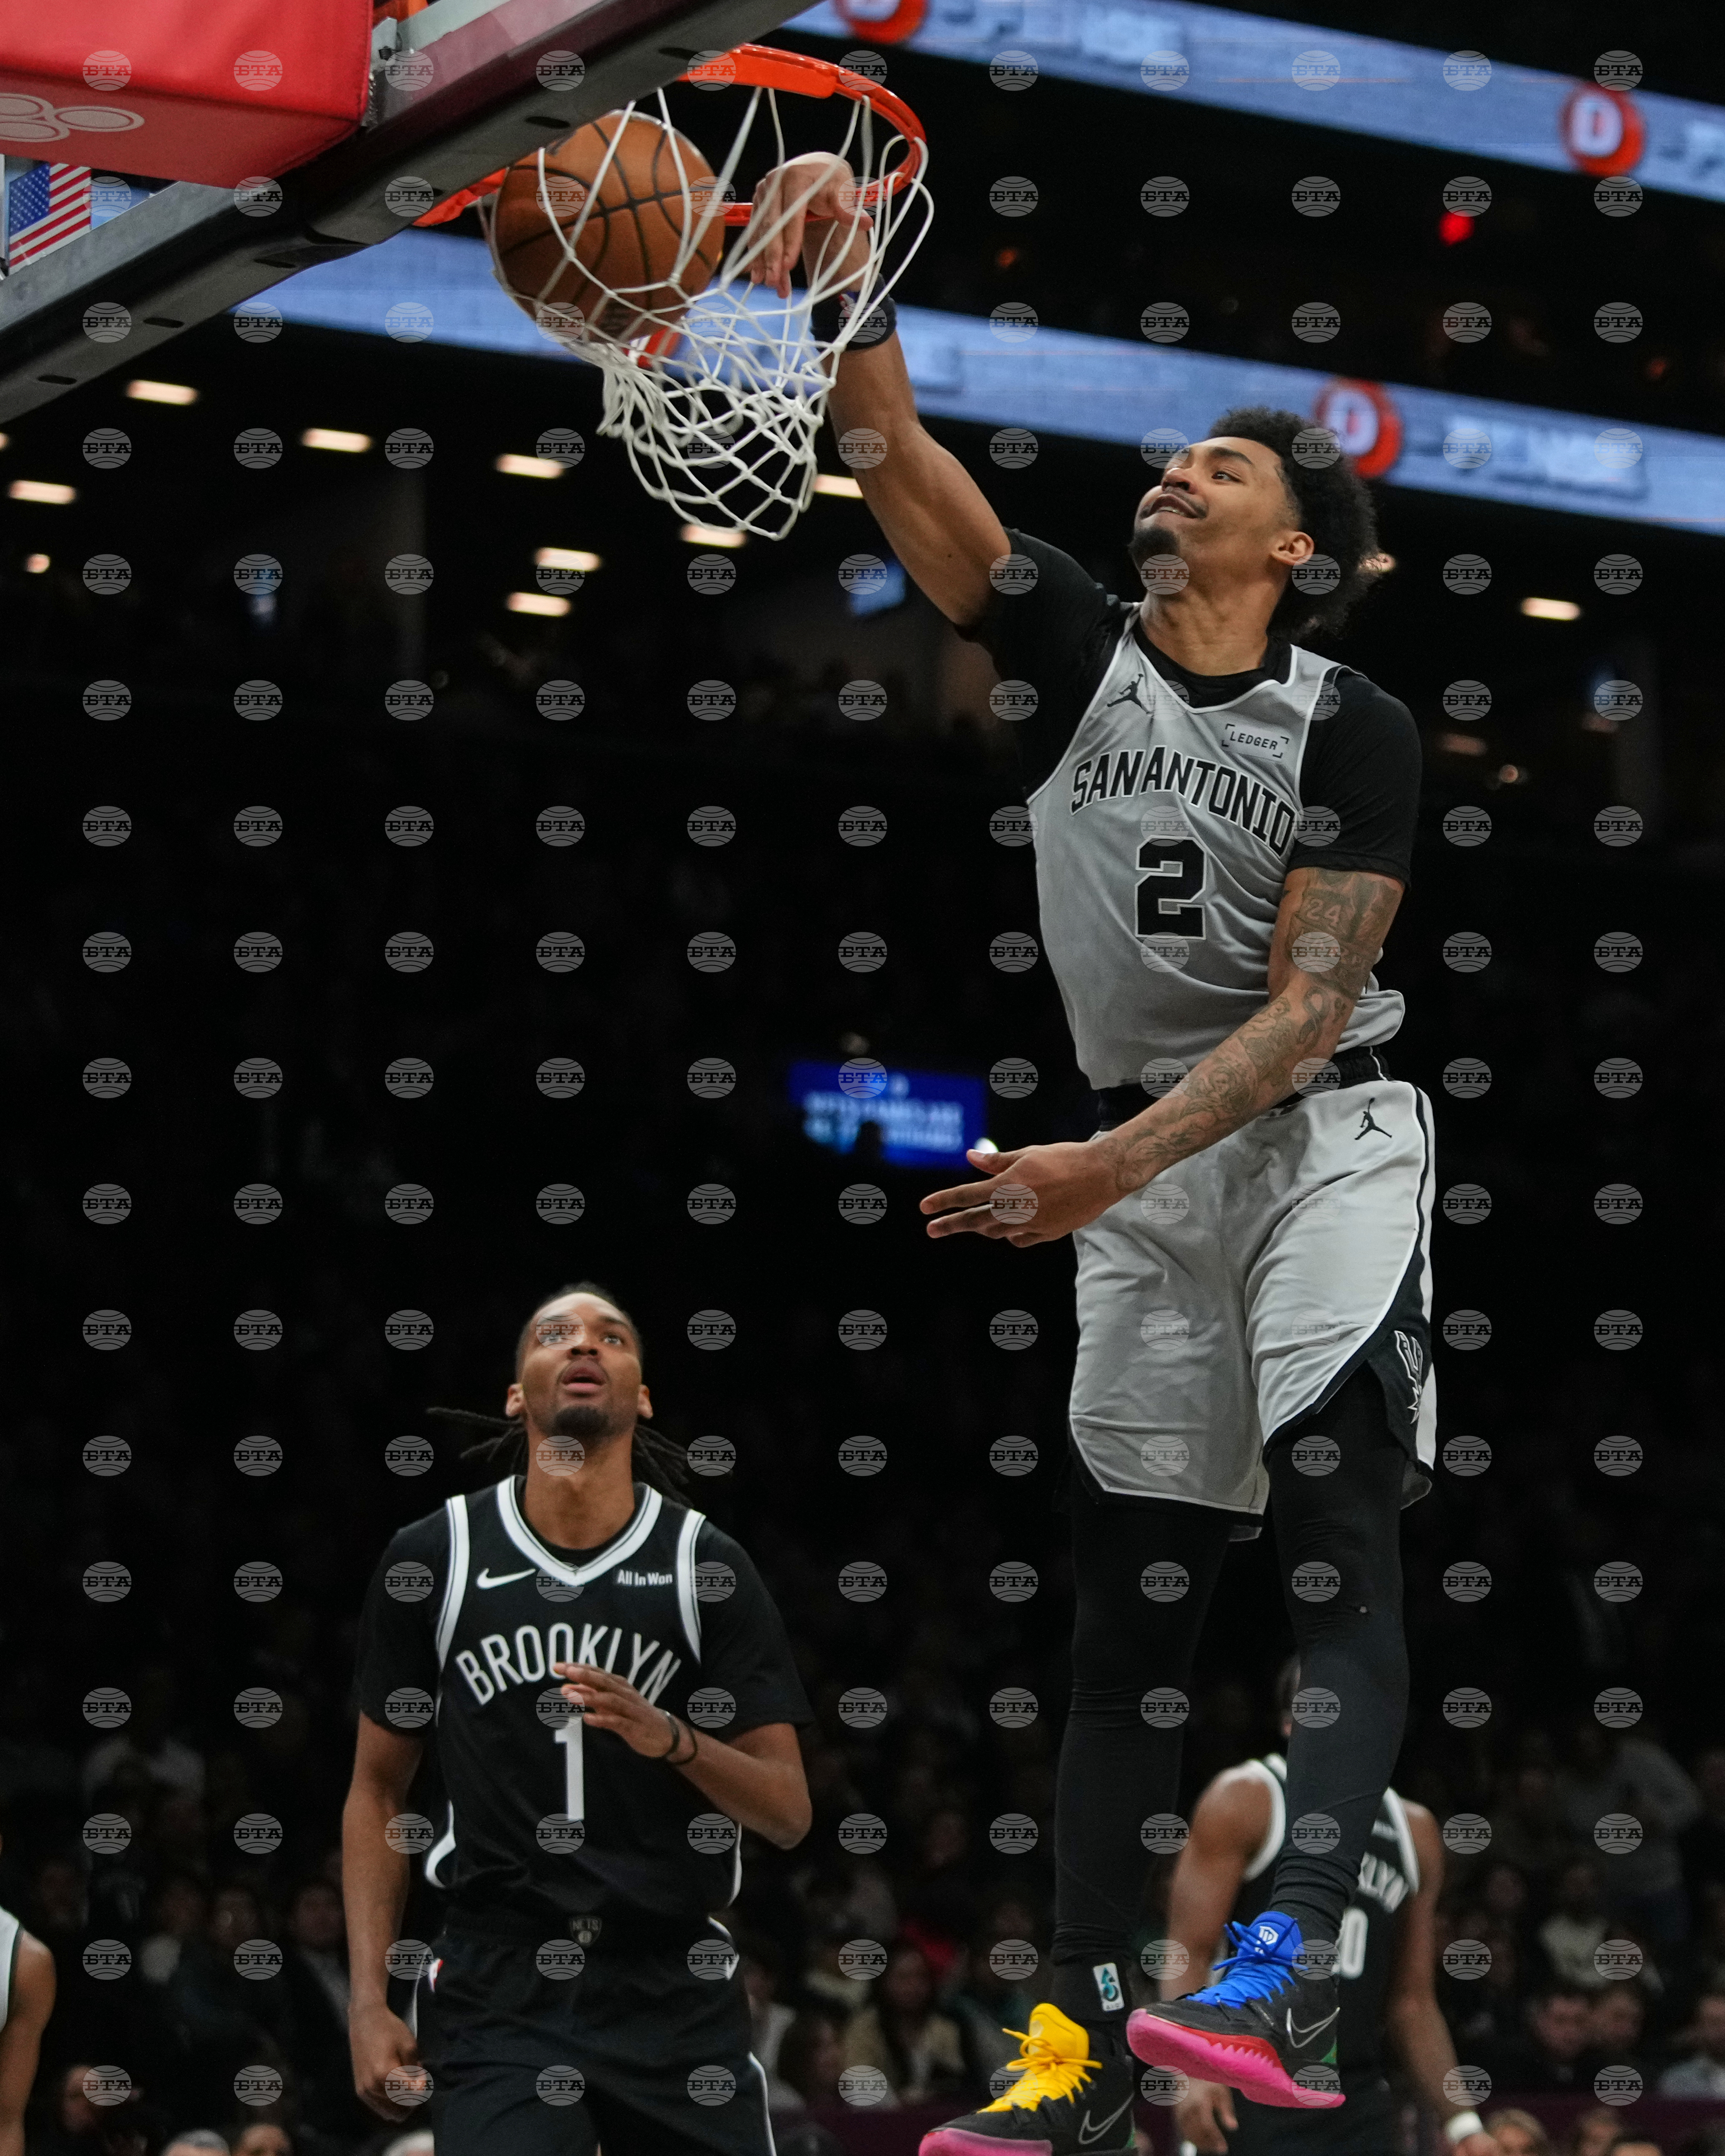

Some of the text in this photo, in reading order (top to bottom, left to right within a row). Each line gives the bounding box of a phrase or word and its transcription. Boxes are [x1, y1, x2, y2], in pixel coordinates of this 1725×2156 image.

[1230, 731, 1278, 750] LEDGER
[1135, 835, 1207, 940] 2
[1306, 898, 1341, 926] 24
[617, 1569, 673, 1586] All In Won
[555, 1716, 585, 1821] 1
[1332, 1907, 1369, 1980] 0
